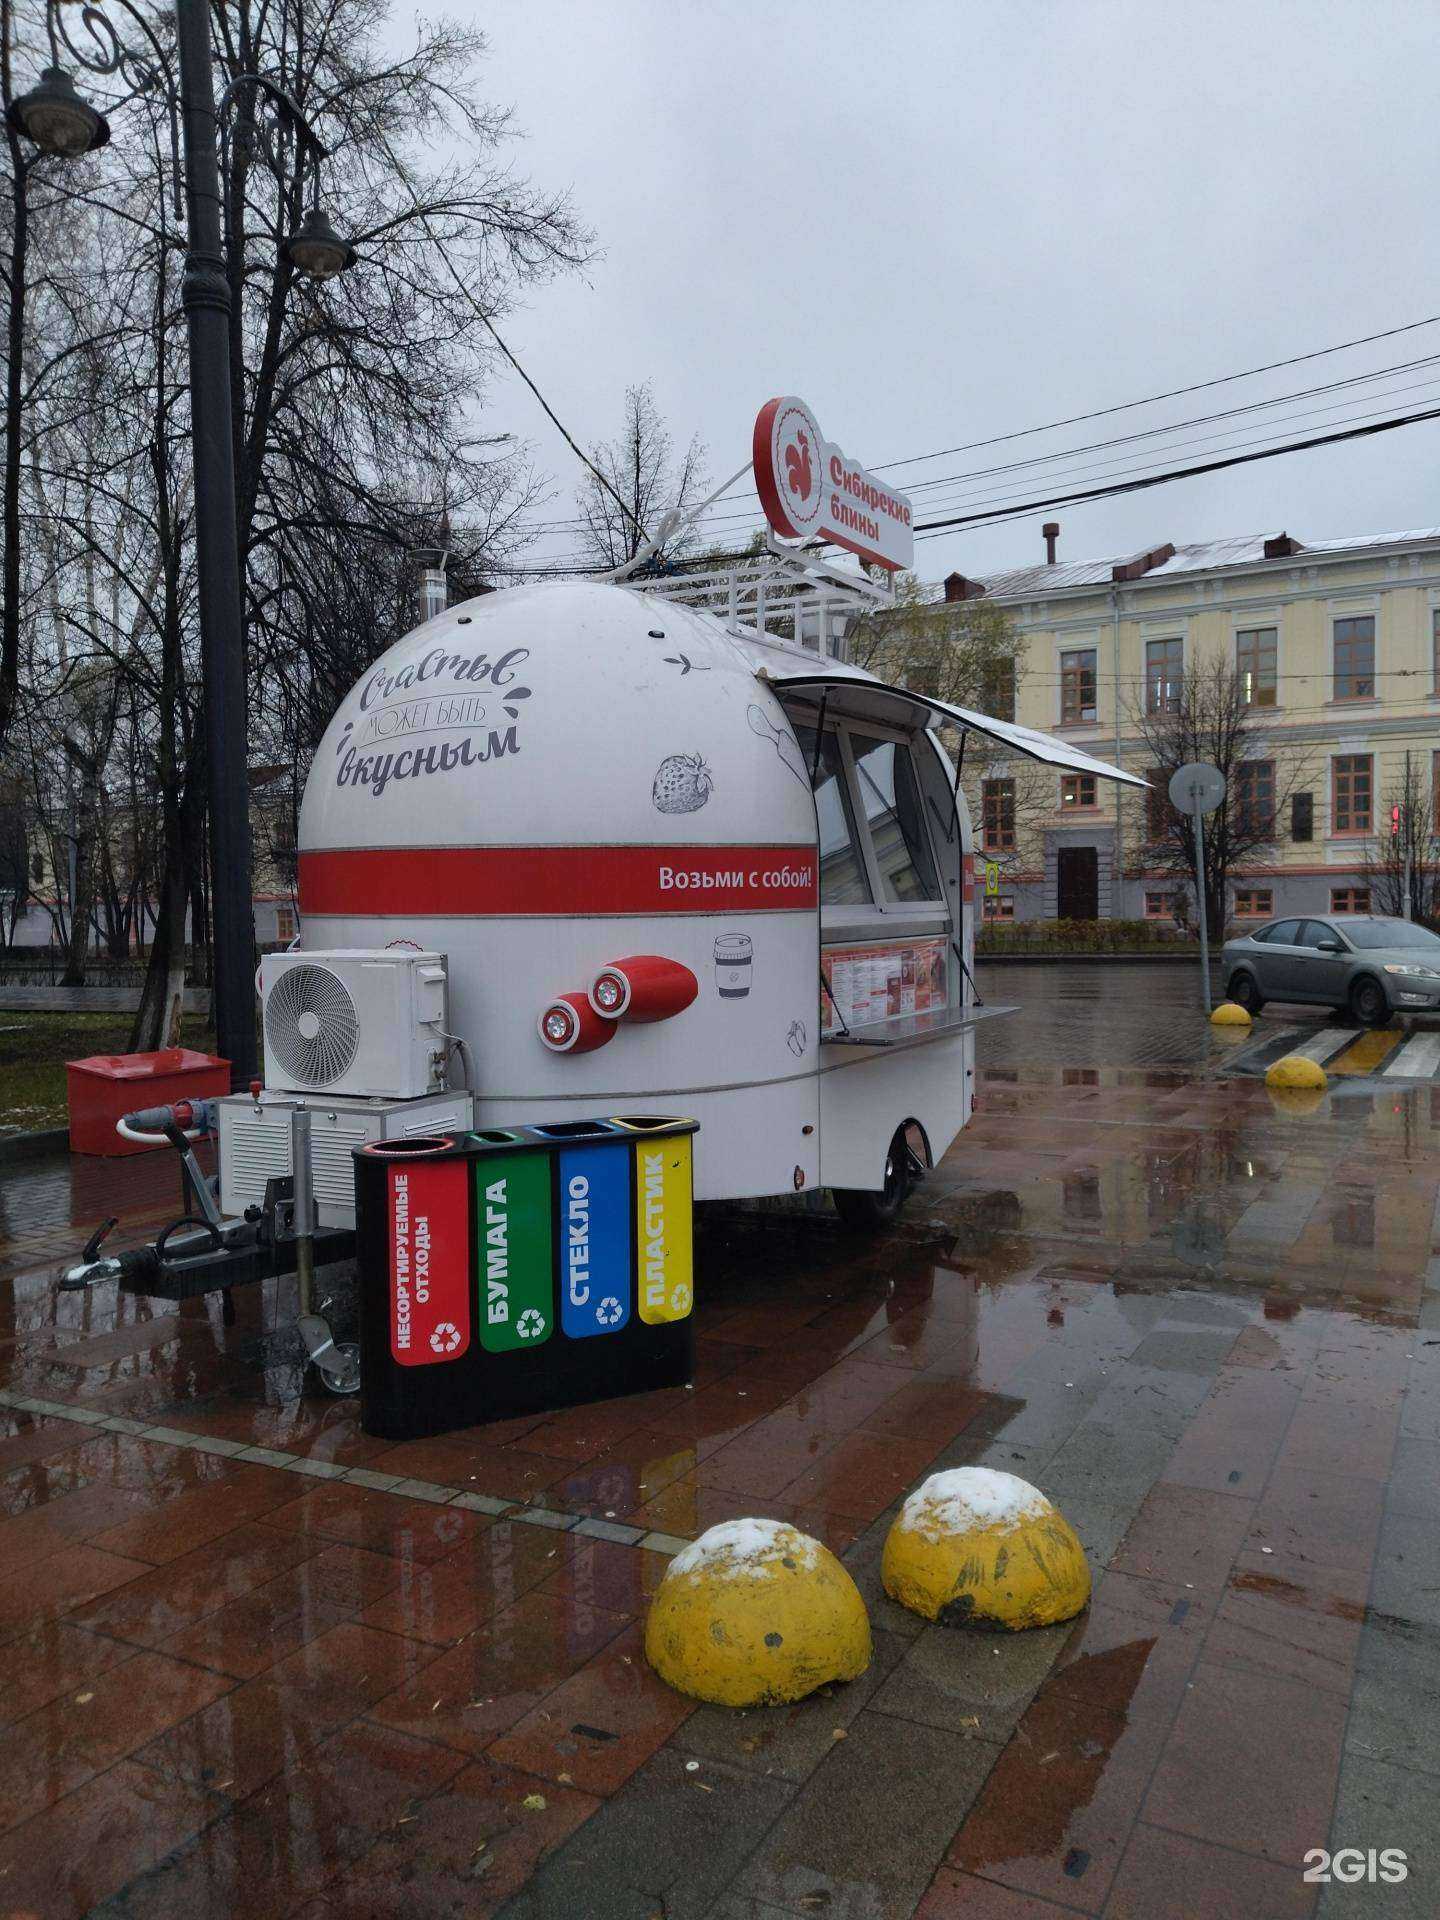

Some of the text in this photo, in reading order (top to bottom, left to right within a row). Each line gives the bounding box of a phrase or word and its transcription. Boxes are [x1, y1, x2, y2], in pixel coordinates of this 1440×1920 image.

[830, 455, 911, 527] Сибирские
[830, 494, 880, 541] блины
[437, 698, 487, 725] БЫТЬ
[336, 725, 521, 797] вкусным
[659, 866, 812, 890] Возьми с собой!
[394, 1174, 411, 1349] НЕСОРТИРУЕМЫЕ
[415, 1216, 430, 1304] ОТХОДЫ
[485, 1178, 509, 1325] БУМАГА
[568, 1175, 590, 1306] СТЕКЛО
[645, 1152, 665, 1307] ПЛАСТИК
